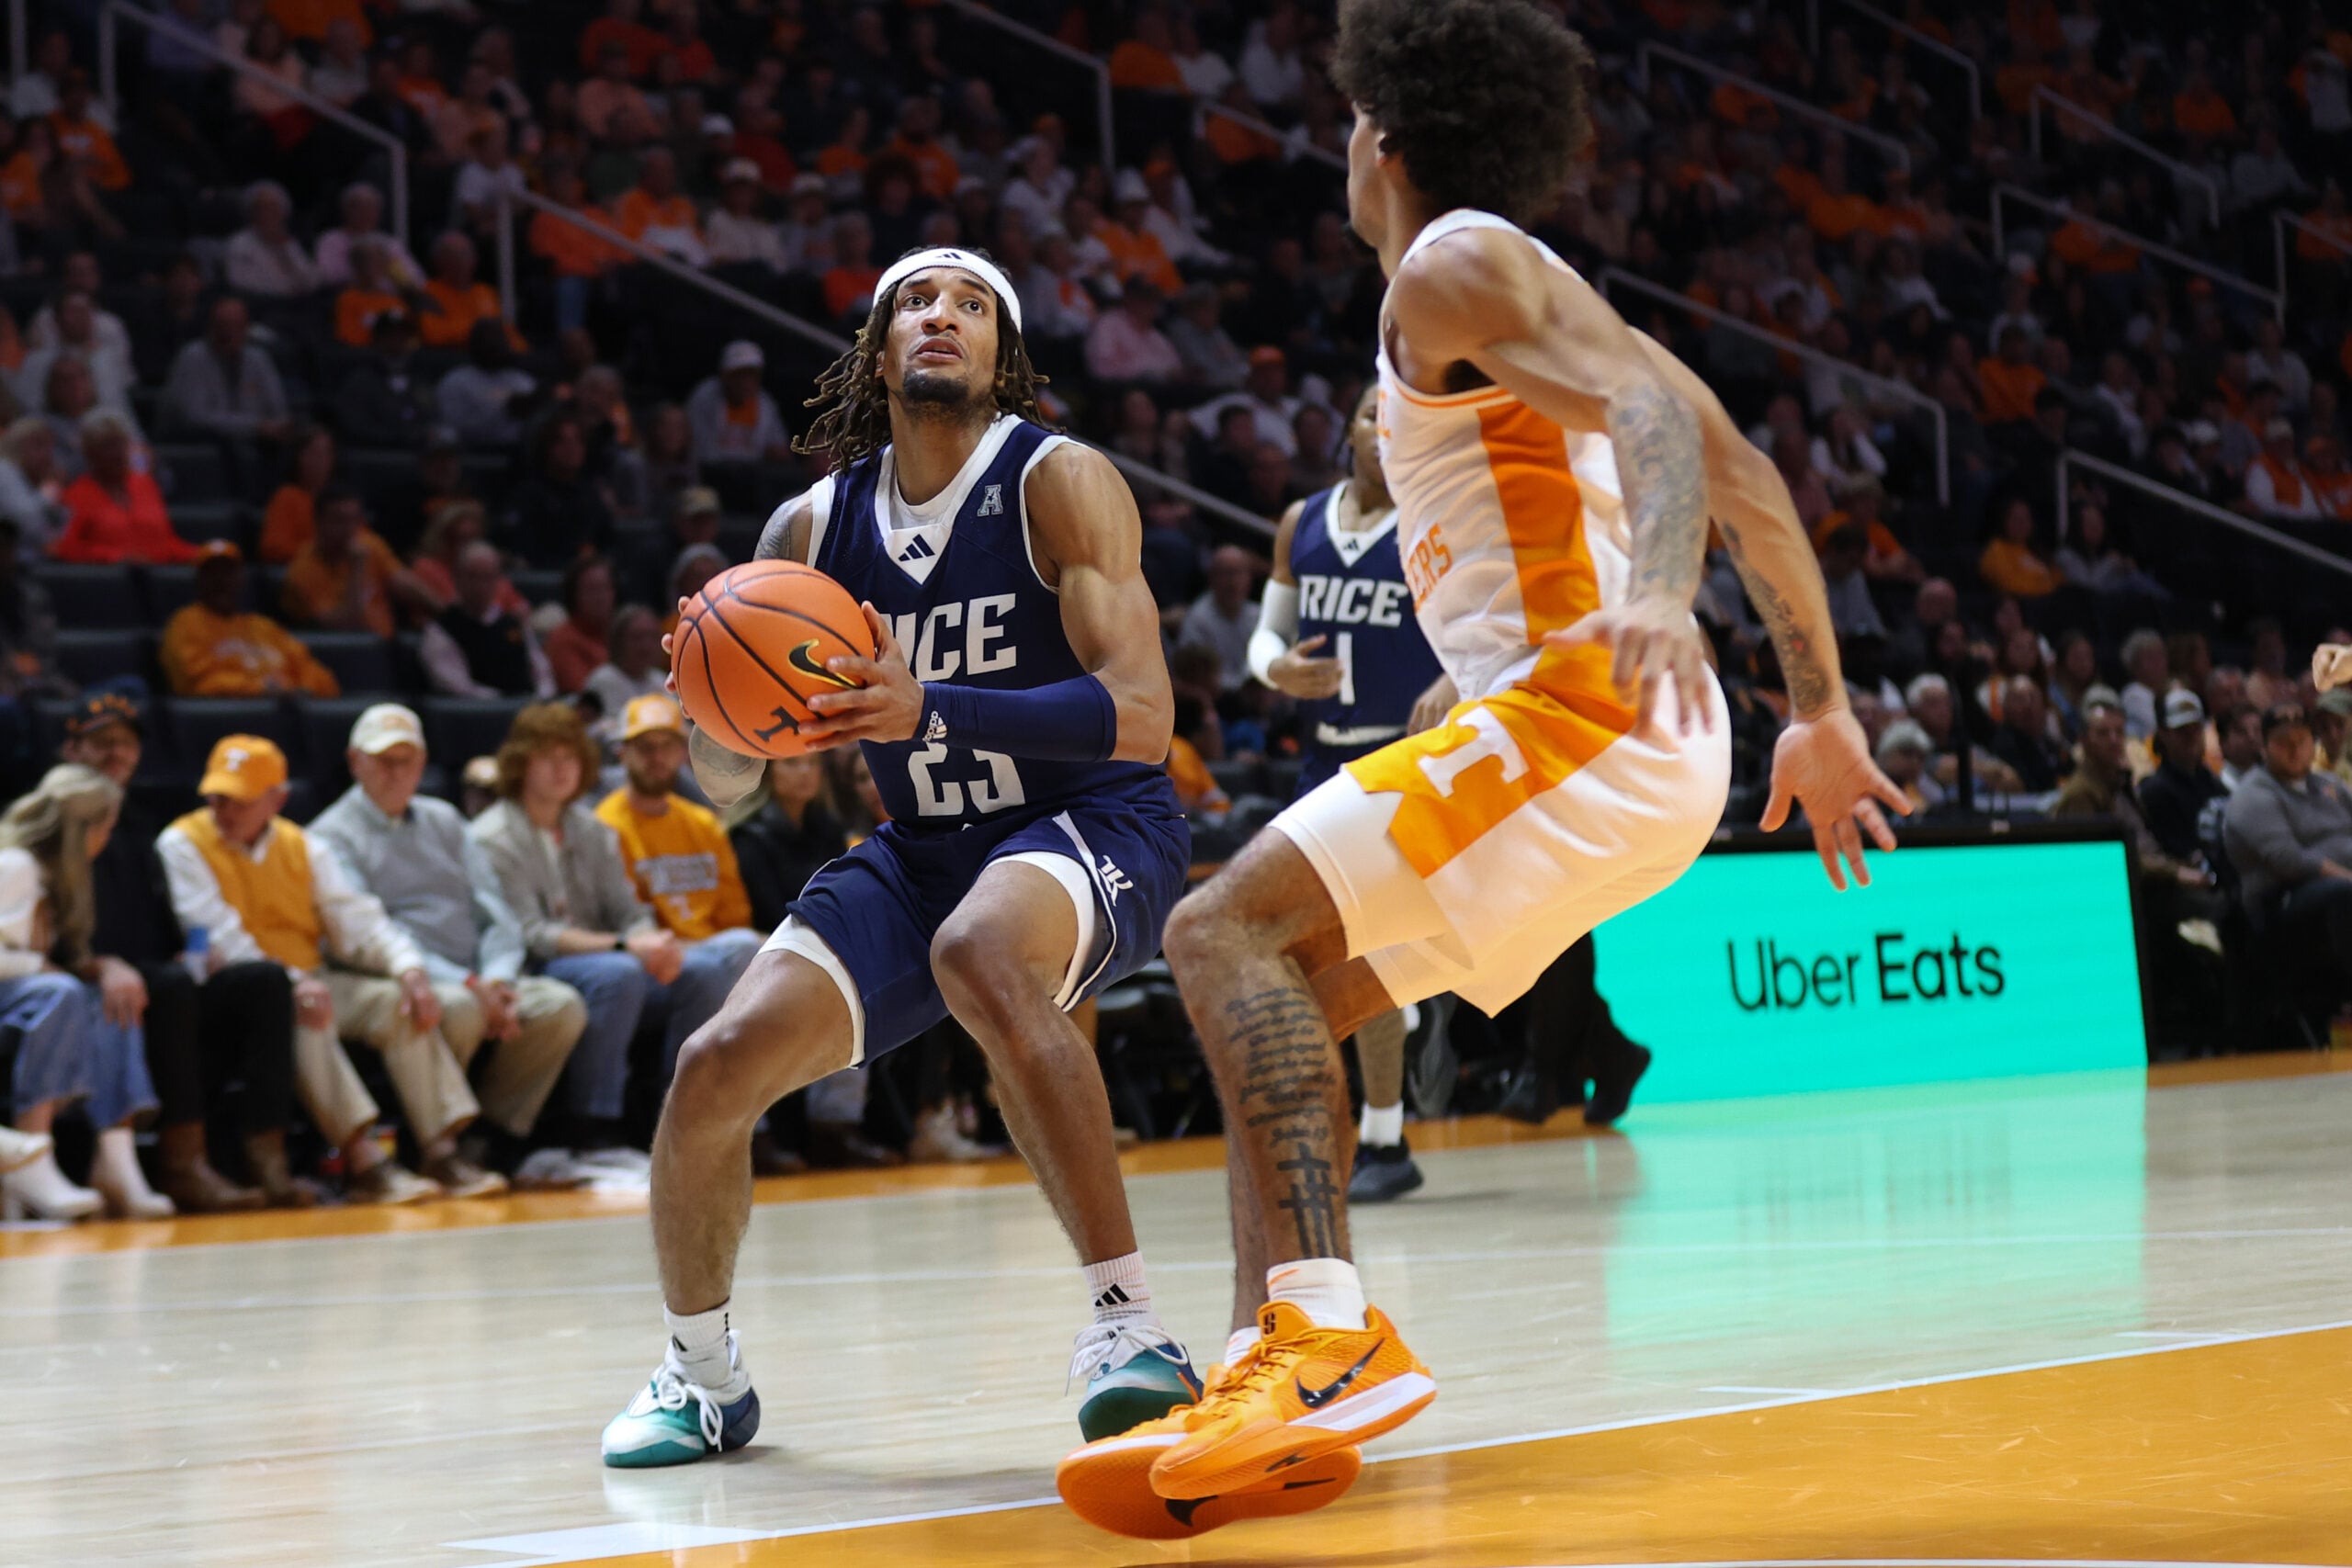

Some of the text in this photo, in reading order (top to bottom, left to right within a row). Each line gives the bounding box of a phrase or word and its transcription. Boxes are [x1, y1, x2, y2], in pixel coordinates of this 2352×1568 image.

[878, 592, 1017, 682] ICE
[1296, 575, 1410, 628] RICE
[1335, 631, 1356, 705] 1
[1417, 705, 1531, 798] T
[1727, 931, 2005, 1010] Uber Eats
